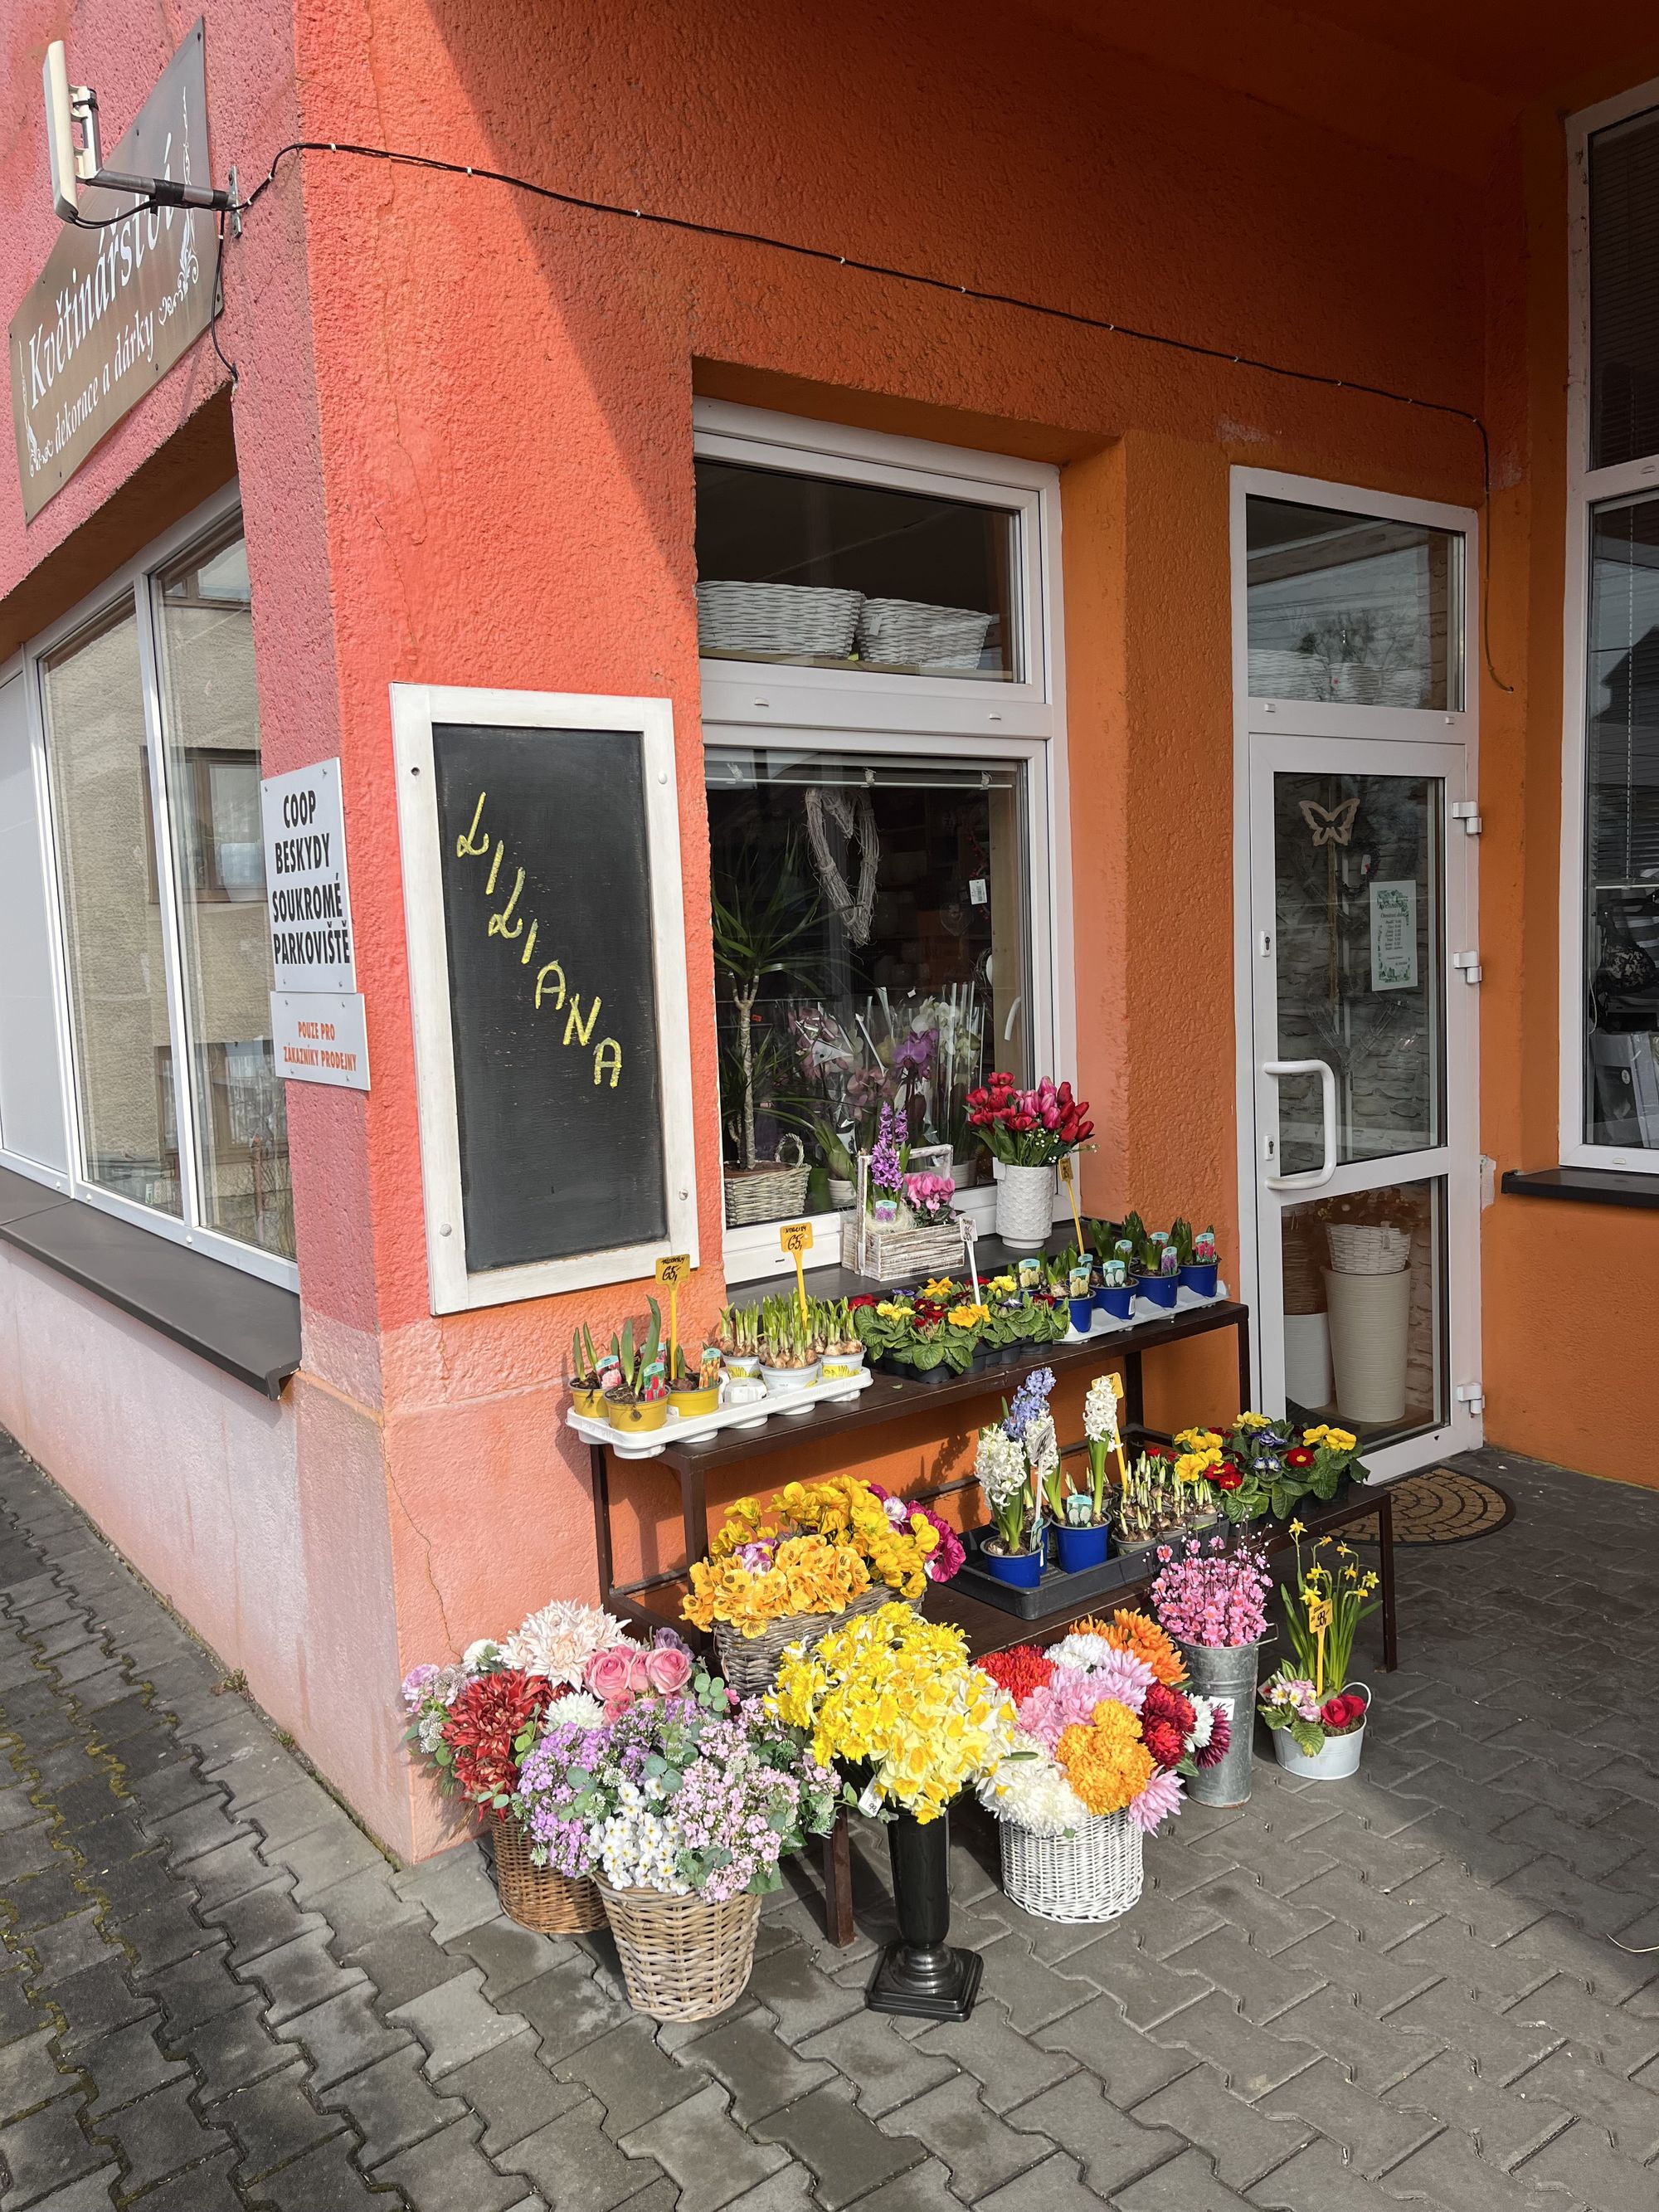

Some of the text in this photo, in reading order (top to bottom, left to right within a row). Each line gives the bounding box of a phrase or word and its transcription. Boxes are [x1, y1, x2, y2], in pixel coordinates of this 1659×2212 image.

[28, 132, 174, 409] Květinářství
[55, 309, 154, 455] dekorace a dárky
[283, 790, 317, 829] COOP
[275, 832, 330, 875] BESKYDY
[272, 872, 343, 923] SOUKROMÉ
[273, 919, 350, 965] PARKOVIŠTĚ
[456, 791, 622, 1089] LILIANA
[298, 1021, 335, 1041] POUZE PRO
[283, 1042, 357, 1072] ZÁKAZNÍKY PRODEJNY
